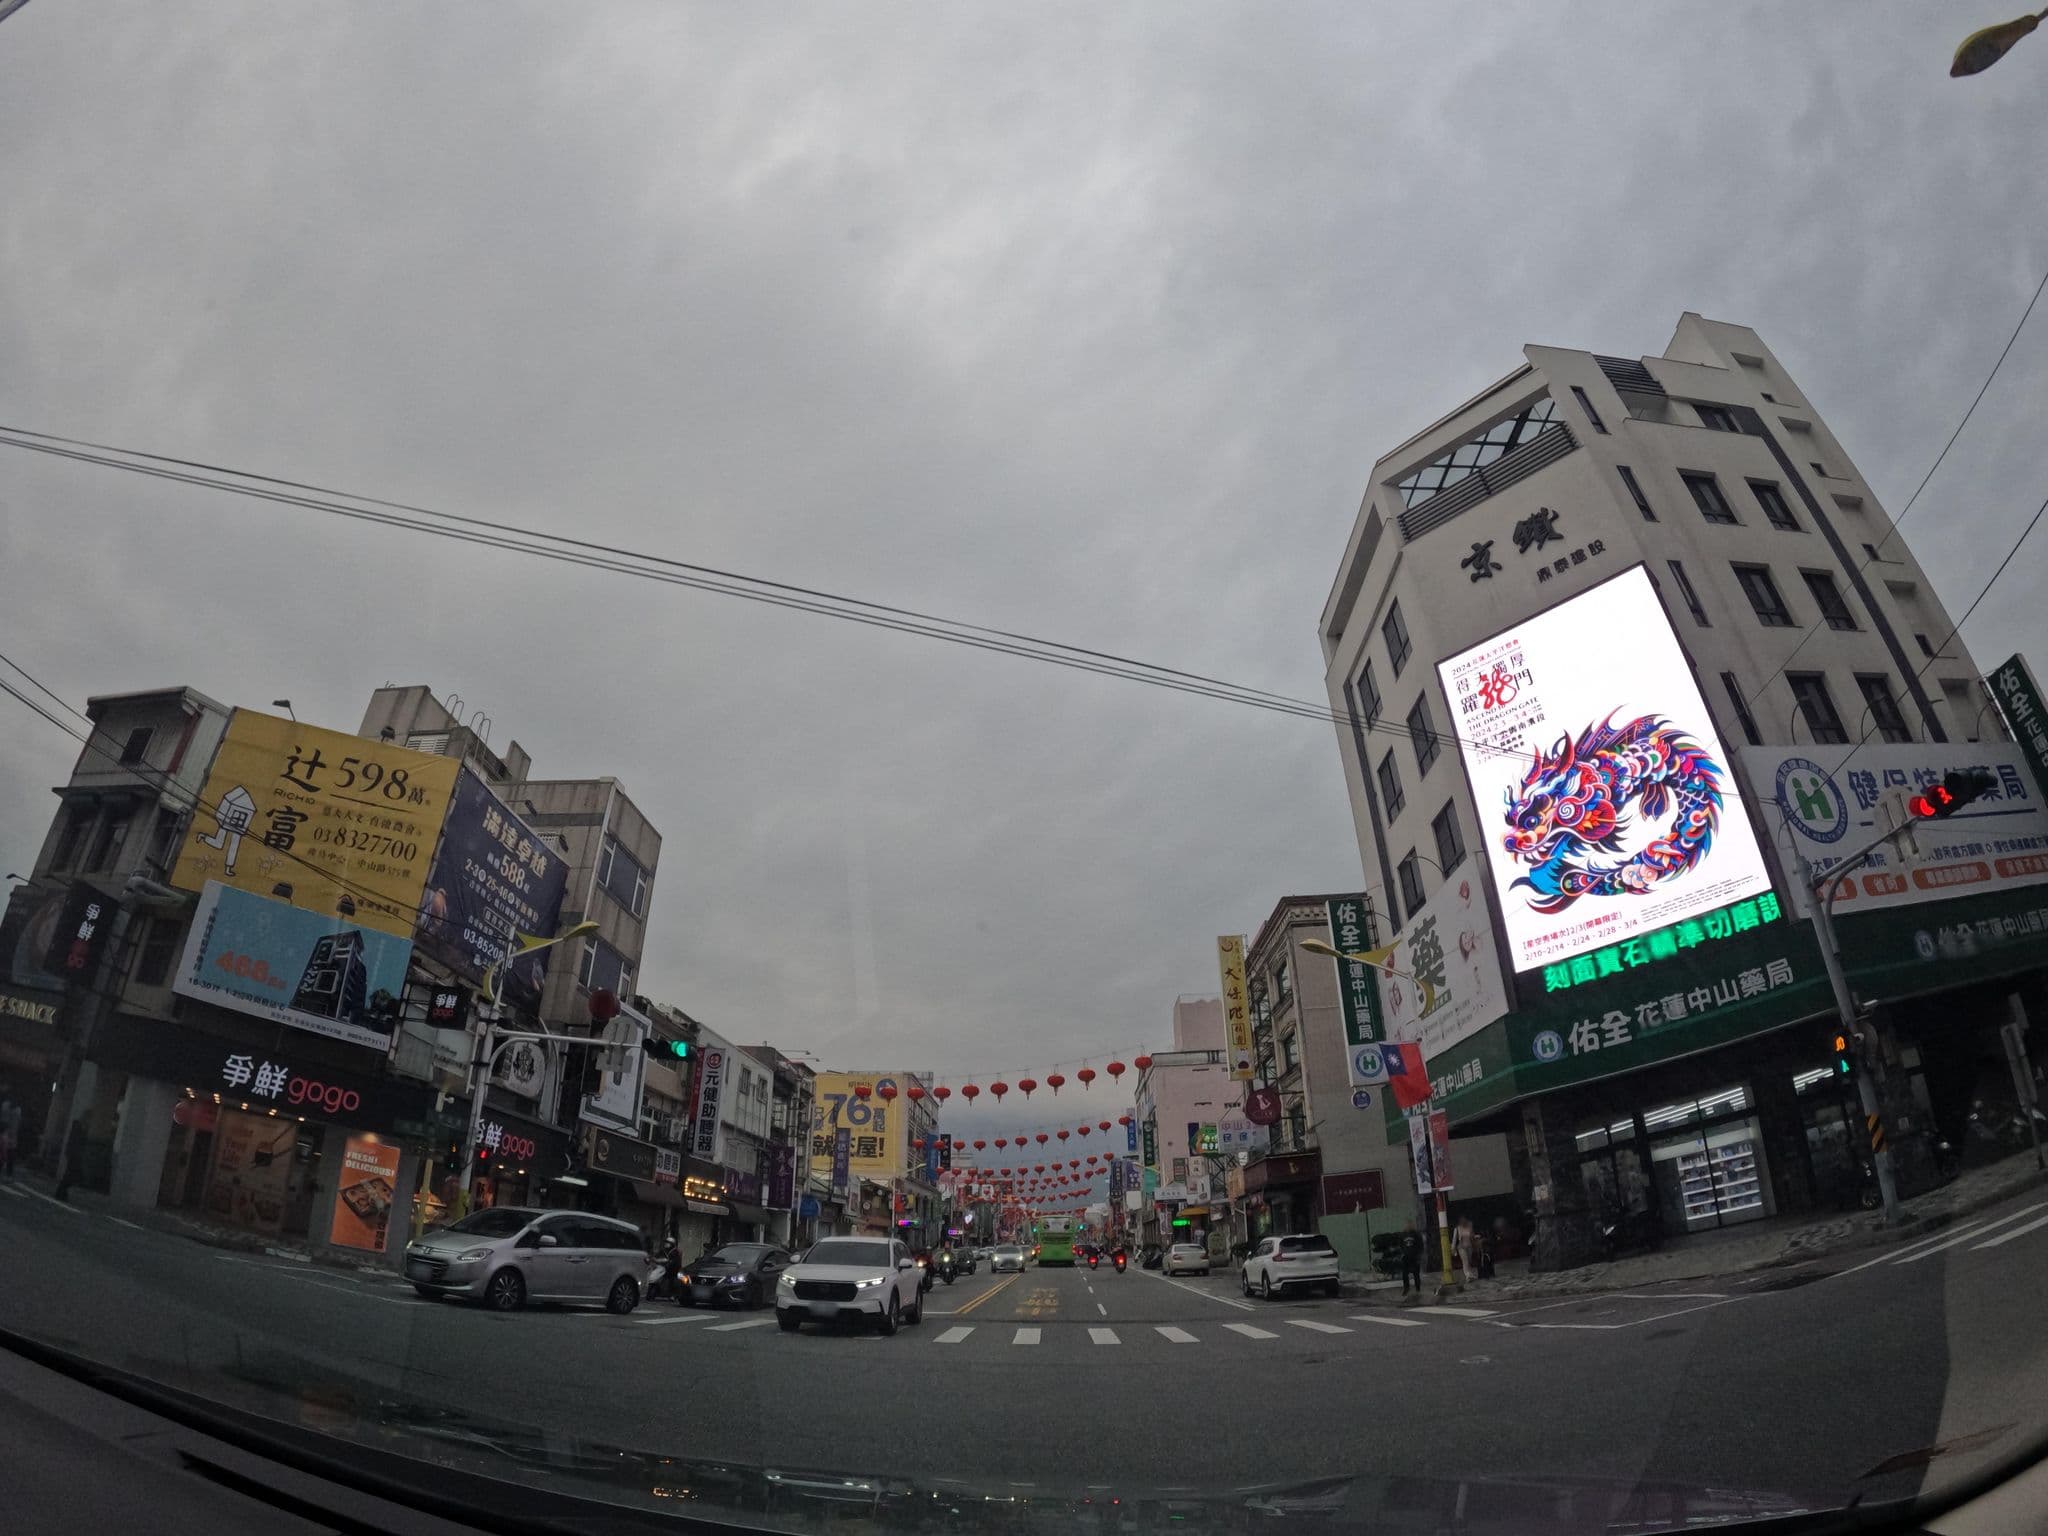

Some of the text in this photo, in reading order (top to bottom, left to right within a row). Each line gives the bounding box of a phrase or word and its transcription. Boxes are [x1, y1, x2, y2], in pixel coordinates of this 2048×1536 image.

[333, 827, 417, 862] 8327700
[77, 903, 100, 942] 爭鮮
[1337, 902, 1374, 1041] 佑全蓮中山藥局
[1568, 958, 1794, 1055] 佑全花蓮中山藥局
[222, 1053, 360, 1114] 爭鮮 gogo
[698, 1070, 720, 1152] 元健助聽器
[823, 1093, 872, 1126] 76
[346, 1151, 378, 1165] FRESH!
[500, 1133, 535, 1161] gogo
[813, 1135, 885, 1158] 就屋!
[344, 1160, 396, 1177] DELICIOUS!
